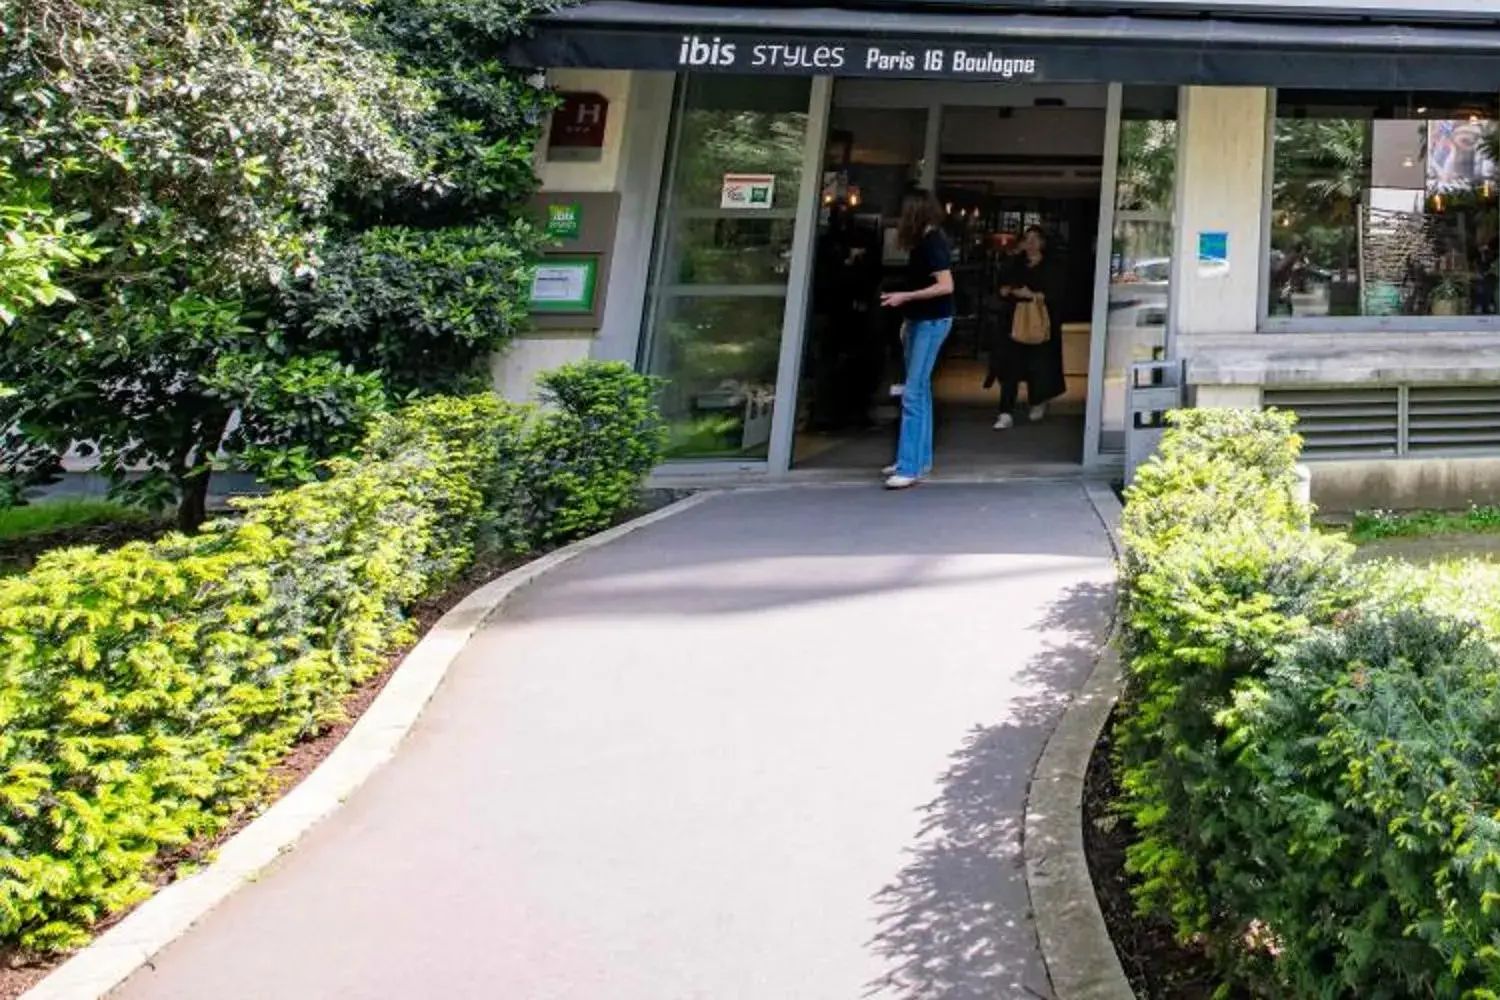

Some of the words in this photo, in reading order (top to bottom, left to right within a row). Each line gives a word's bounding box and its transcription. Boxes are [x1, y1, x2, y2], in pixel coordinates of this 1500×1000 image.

[679, 36, 736, 66] ibis
[866, 48, 914, 71] Paris
[923, 50, 943, 71] 16
[952, 52, 1035, 77] Boulogne
[577, 103, 601, 124] H
